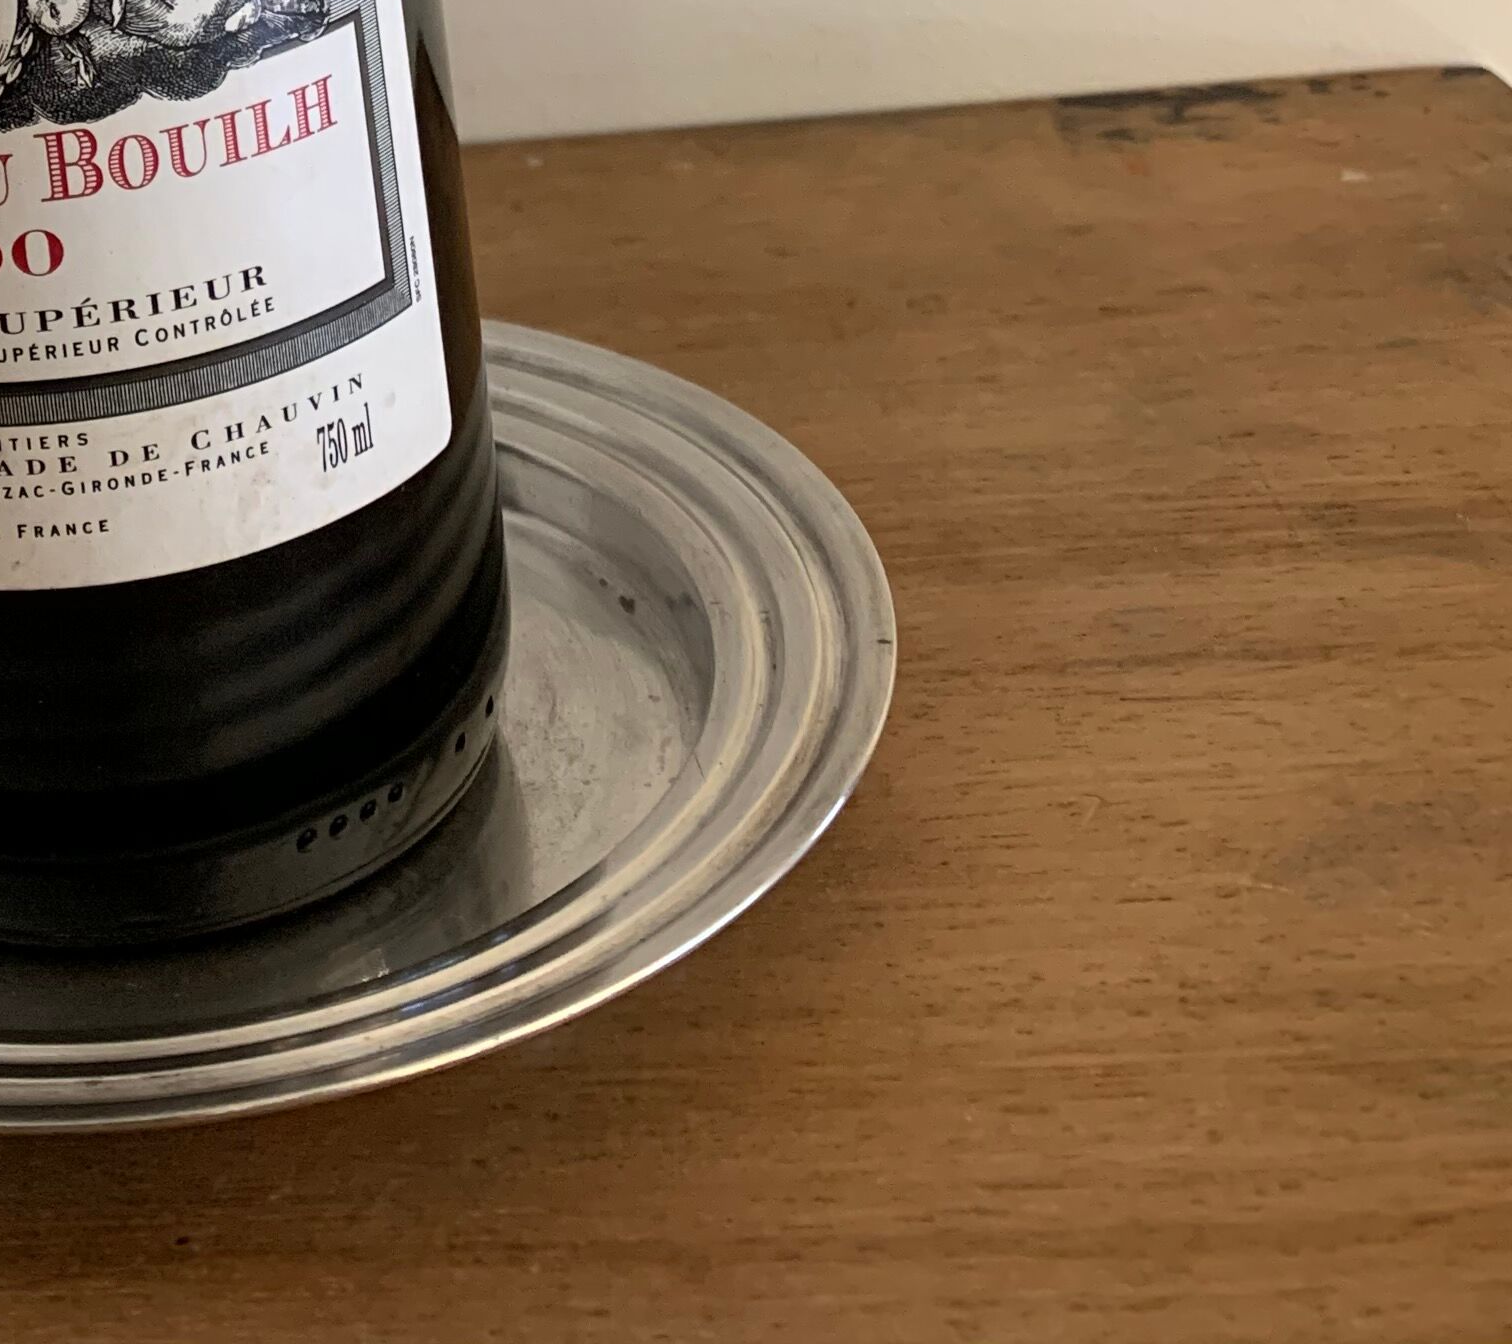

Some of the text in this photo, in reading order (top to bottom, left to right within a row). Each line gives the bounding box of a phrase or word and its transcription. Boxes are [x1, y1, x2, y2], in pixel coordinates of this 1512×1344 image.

[33, 74, 338, 202] BOUILH
[134, 296, 276, 347] CONTRÔLÉE
[108, 443, 160, 468] DE
[190, 373, 364, 451] CHAUVIN
[316, 402, 375, 472] 750 ml
[17, 519, 110, 539] FRANCE
